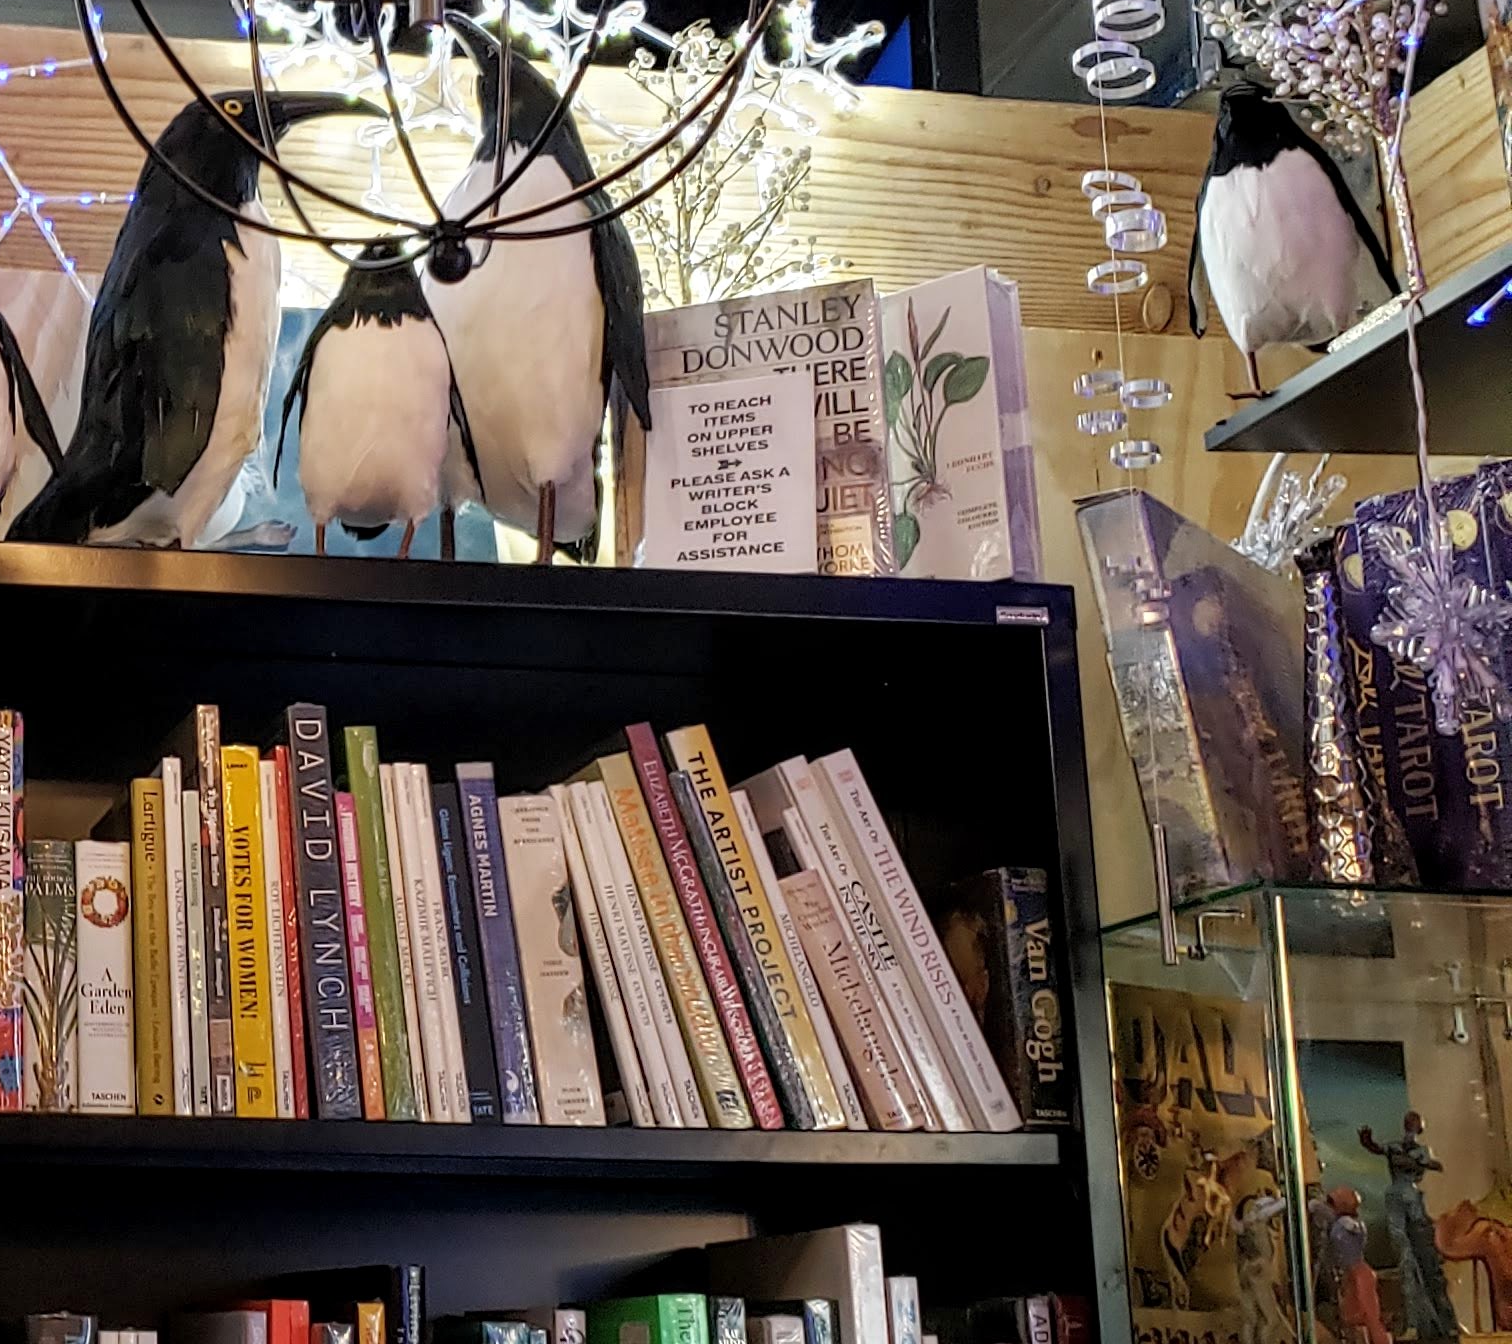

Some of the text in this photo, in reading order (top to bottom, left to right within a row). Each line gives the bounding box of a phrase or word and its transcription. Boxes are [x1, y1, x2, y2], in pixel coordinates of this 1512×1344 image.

[714, 294, 862, 338] STANLEY
[682, 327, 864, 374] DONWOOD
[688, 396, 771, 414] TO REACH
[704, 412, 756, 428] ITEMS
[688, 425, 773, 443] ON UPPER
[834, 420, 871, 446] BE
[692, 440, 769, 457] SHELVES
[671, 467, 790, 489] PLEASE ASK A
[689, 483, 772, 501] WRITER'S
[702, 499, 759, 515] BLOCK
[684, 512, 777, 531] EMPLOYEE
[713, 531, 747, 543] FOR
[677, 543, 785, 562] ASSISTANCE
[1395, 695, 1438, 821] TAROT
[139, 790, 161, 863] Lartigue
[467, 794, 499, 917] AGNES MARTIN
[293, 718, 346, 1031] DAVID LYNCH
[686, 751, 798, 1020] THE ARTIST PROJECT
[232, 825, 259, 1019] VOTES FOR WOMEN!
[871, 843, 957, 1007] THE WIND RISES
[101, 968, 113, 982] A
[80, 983, 133, 1000] Garden
[1024, 918, 1064, 1084] Van Gogh
[89, 998, 126, 1016] Eden
[820, 940, 901, 1092] Michelangelo
[91, 1092, 126, 1102] TASCHEN
[675, 1304, 696, 1343] The
